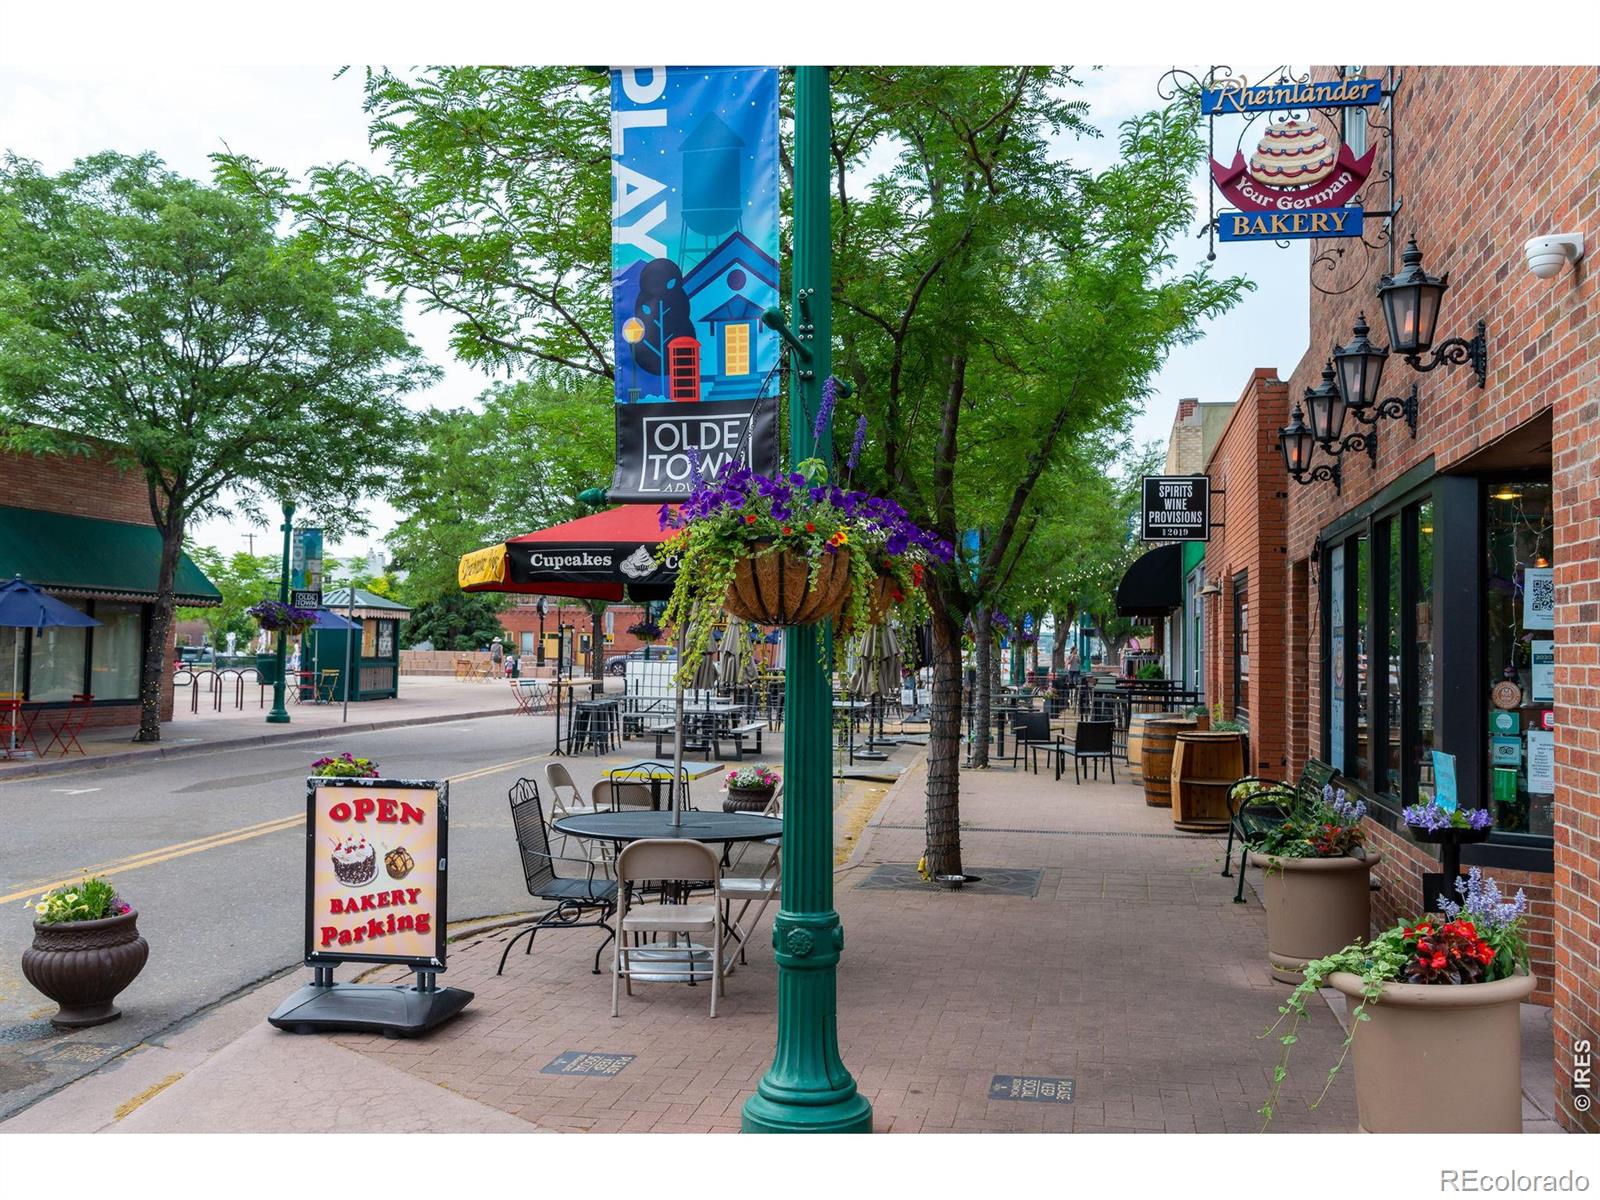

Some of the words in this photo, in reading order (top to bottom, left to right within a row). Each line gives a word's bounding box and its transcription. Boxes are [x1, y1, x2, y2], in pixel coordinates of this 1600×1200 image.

[611, 66, 667, 259] PLAY
[1235, 175, 1273, 207] Your
[1276, 171, 1353, 210] German
[1231, 211, 1349, 236] BAKERY
[654, 420, 740, 451] OLDE
[1159, 485, 1193, 498] SPIRITS
[1164, 498, 1187, 510] WINE
[1148, 511, 1202, 523] PROVISIONS
[530, 553, 612, 570] Cupcakes
[329, 798, 425, 825] OPEN
[330, 887, 423, 914] BAKERY
[320, 912, 432, 947] Parking
